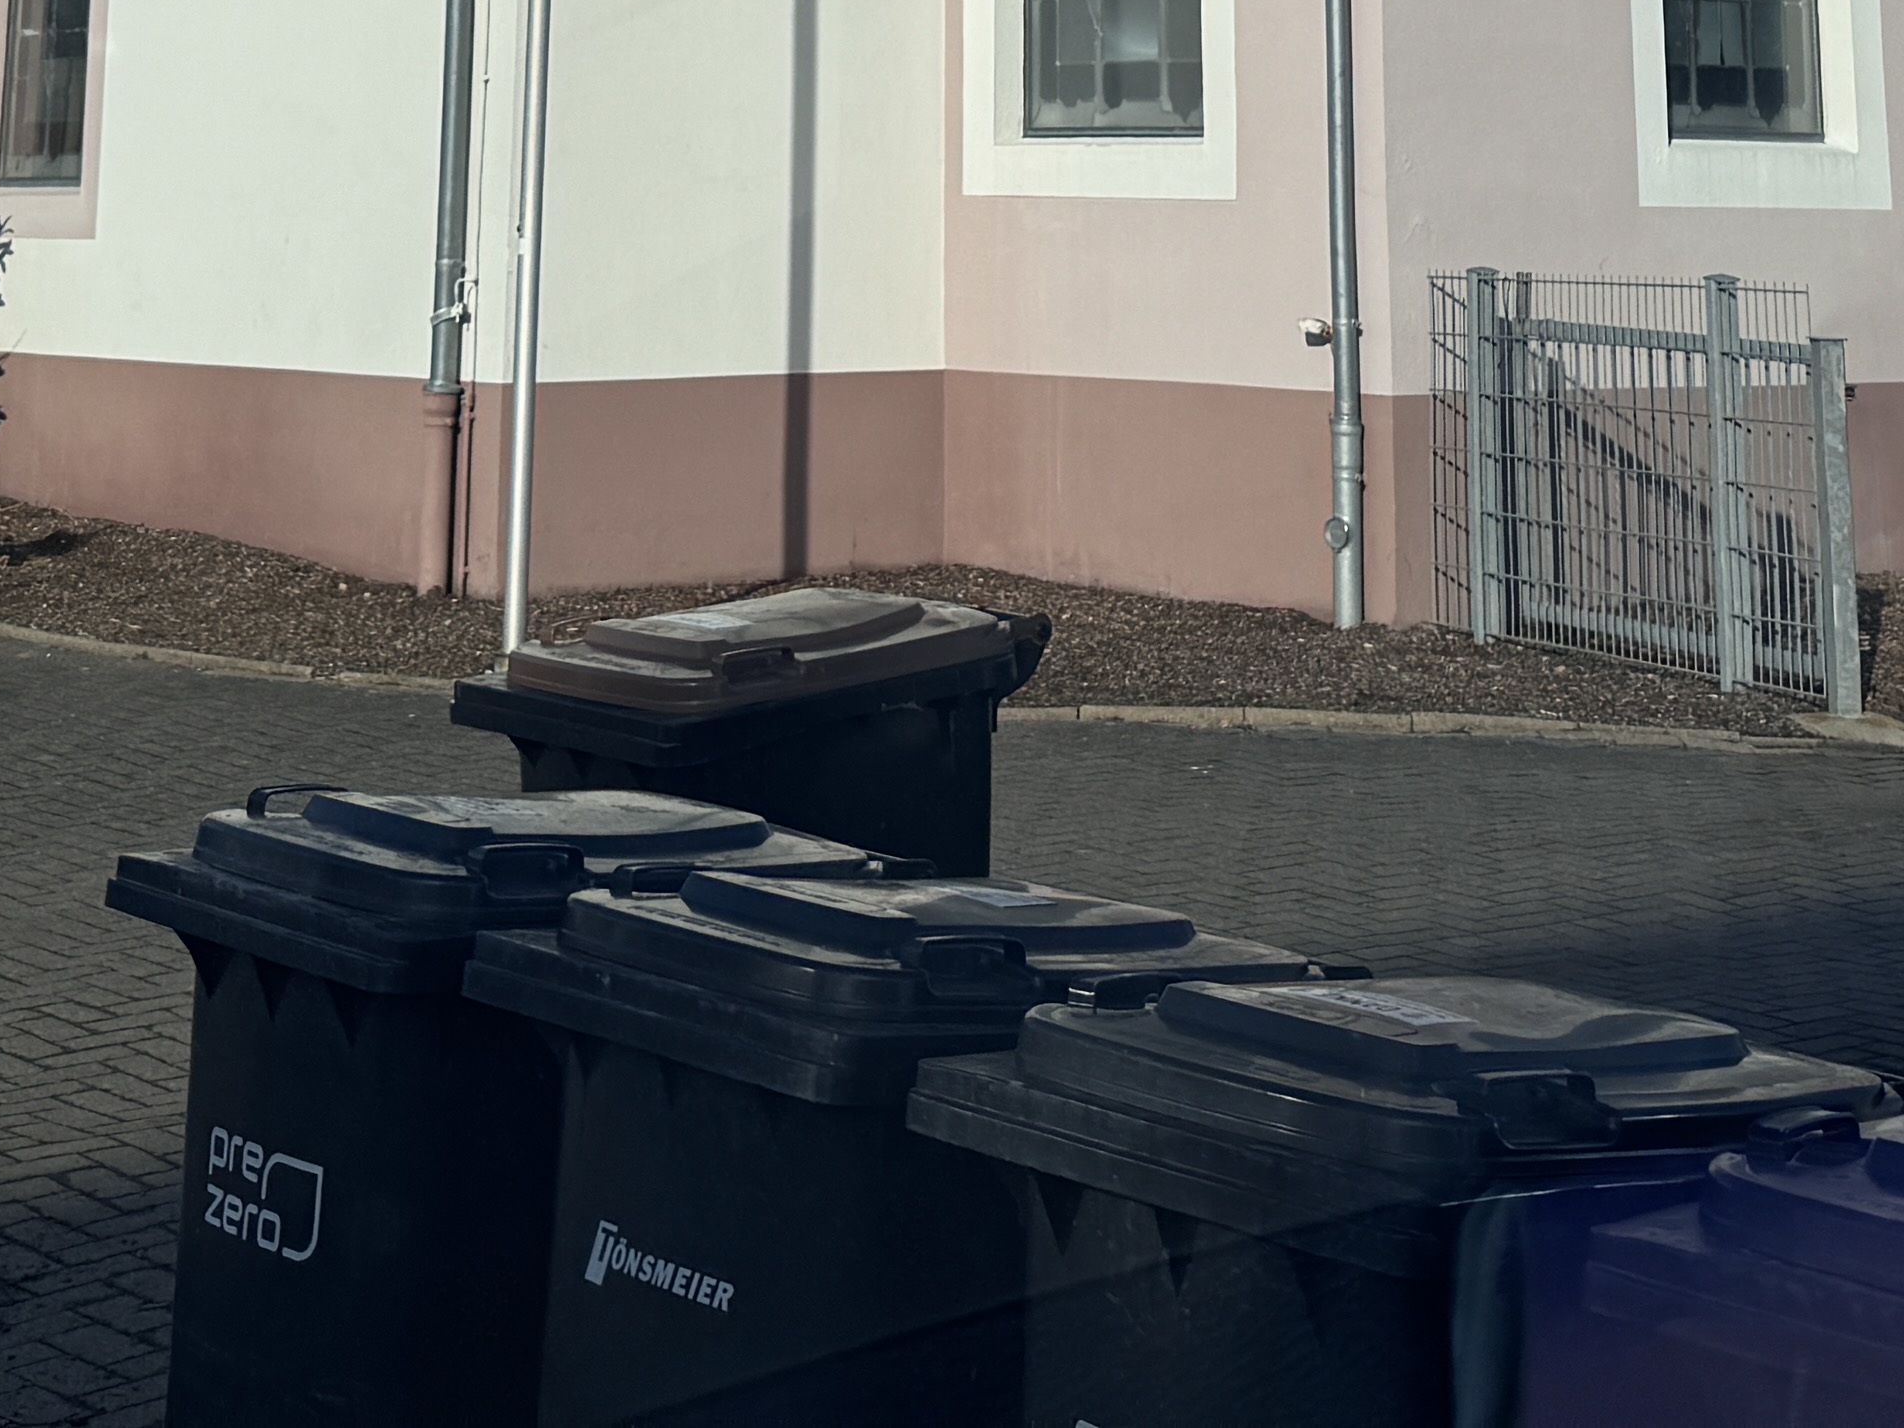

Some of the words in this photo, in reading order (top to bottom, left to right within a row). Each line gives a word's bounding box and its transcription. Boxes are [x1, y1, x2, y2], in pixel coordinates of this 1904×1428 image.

[208, 1126, 264, 1183] pre
[204, 1183, 281, 1252] zero
[584, 1219, 735, 1312] TÖNSMEIER
